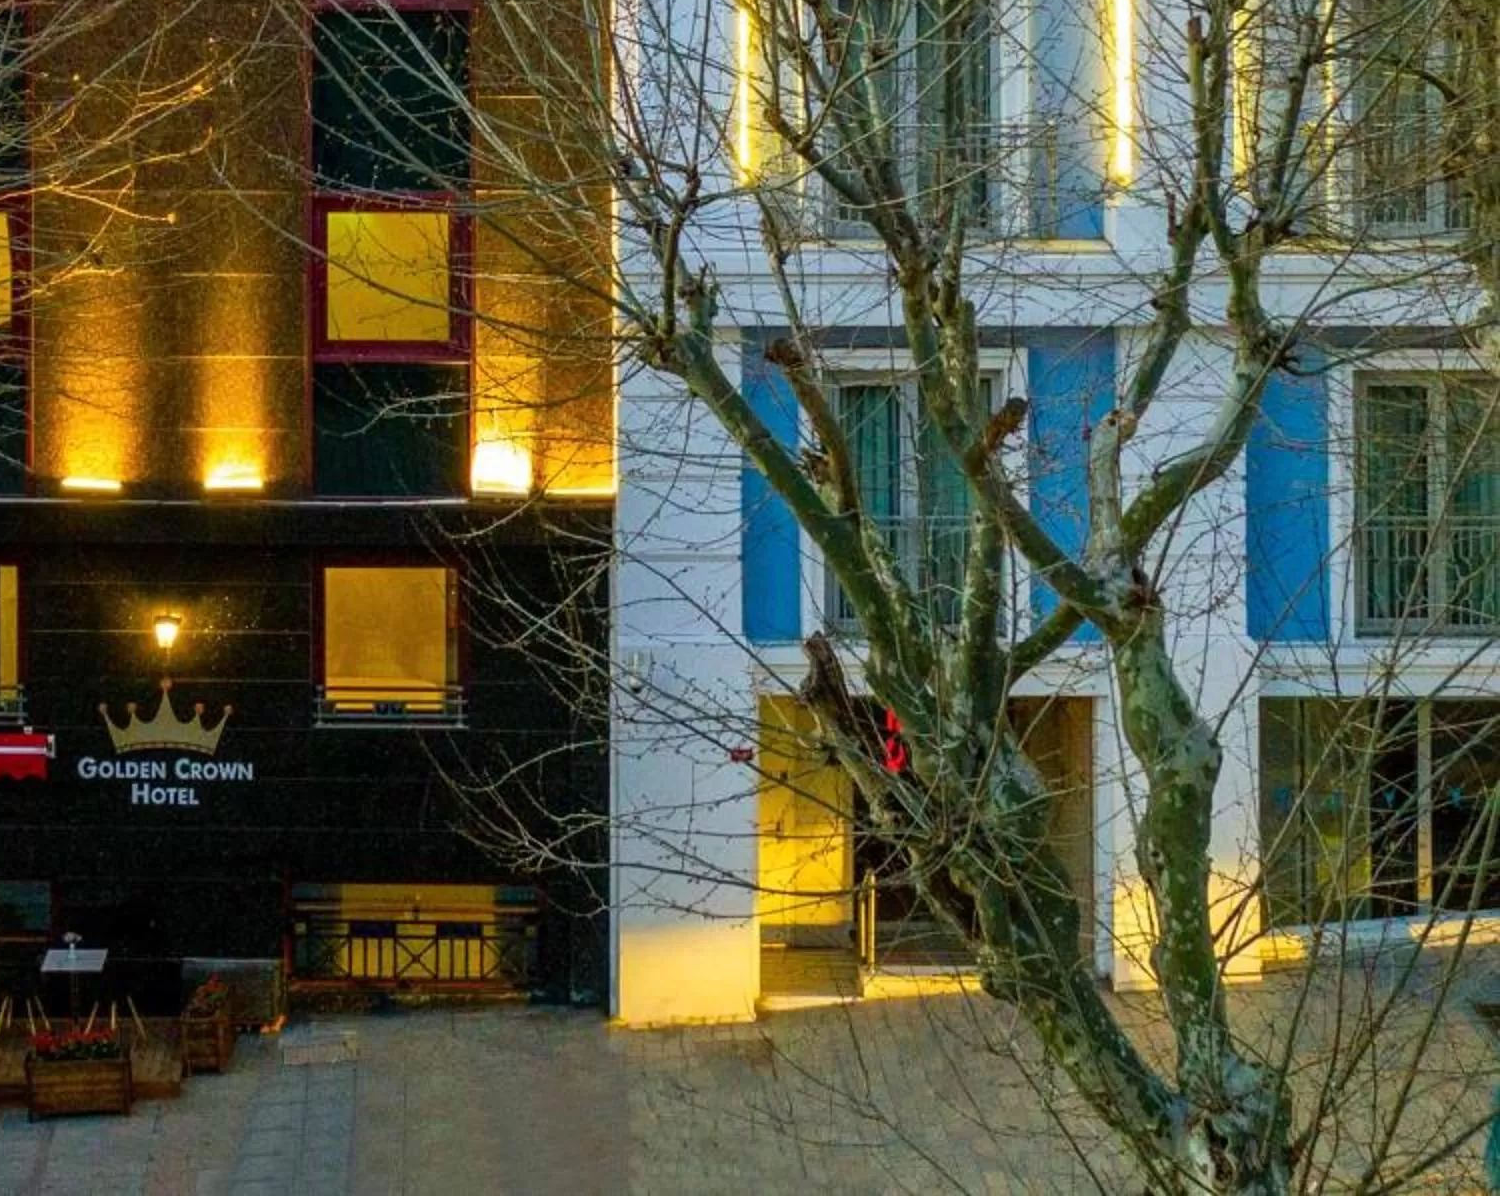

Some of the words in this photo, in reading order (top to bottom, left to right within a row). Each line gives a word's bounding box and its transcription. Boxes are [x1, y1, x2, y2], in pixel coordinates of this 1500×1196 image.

[77, 756, 166, 780] GOLDEN
[174, 757, 254, 781] CROWN
[131, 782, 200, 805] HOTEL
